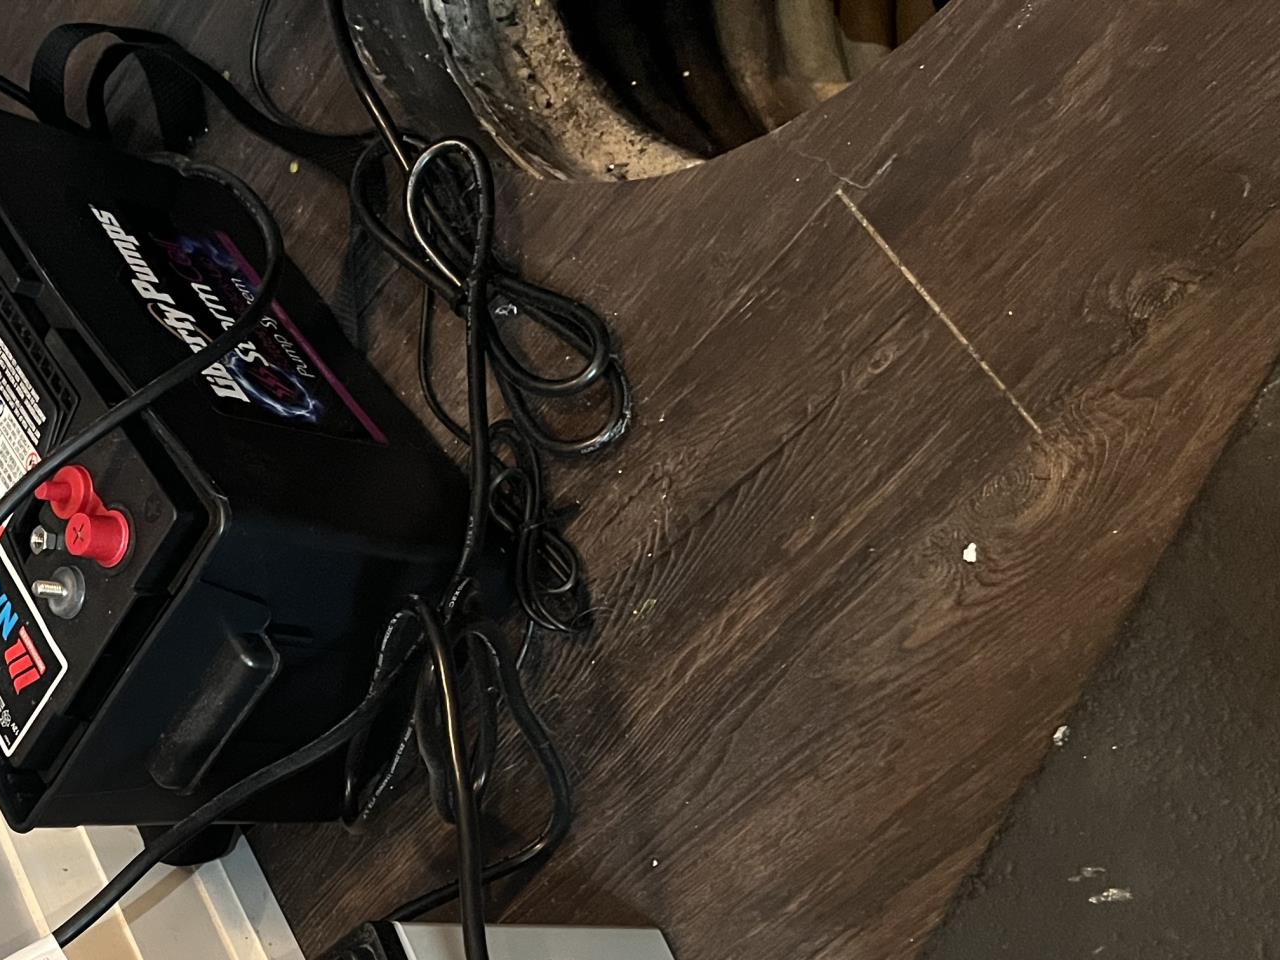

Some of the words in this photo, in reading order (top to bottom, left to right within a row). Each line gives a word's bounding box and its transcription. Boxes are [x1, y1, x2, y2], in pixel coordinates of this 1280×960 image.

[91, 208, 176, 304] Pumps
[231, 278, 275, 326] Syem
[157, 303, 251, 402] Librty
